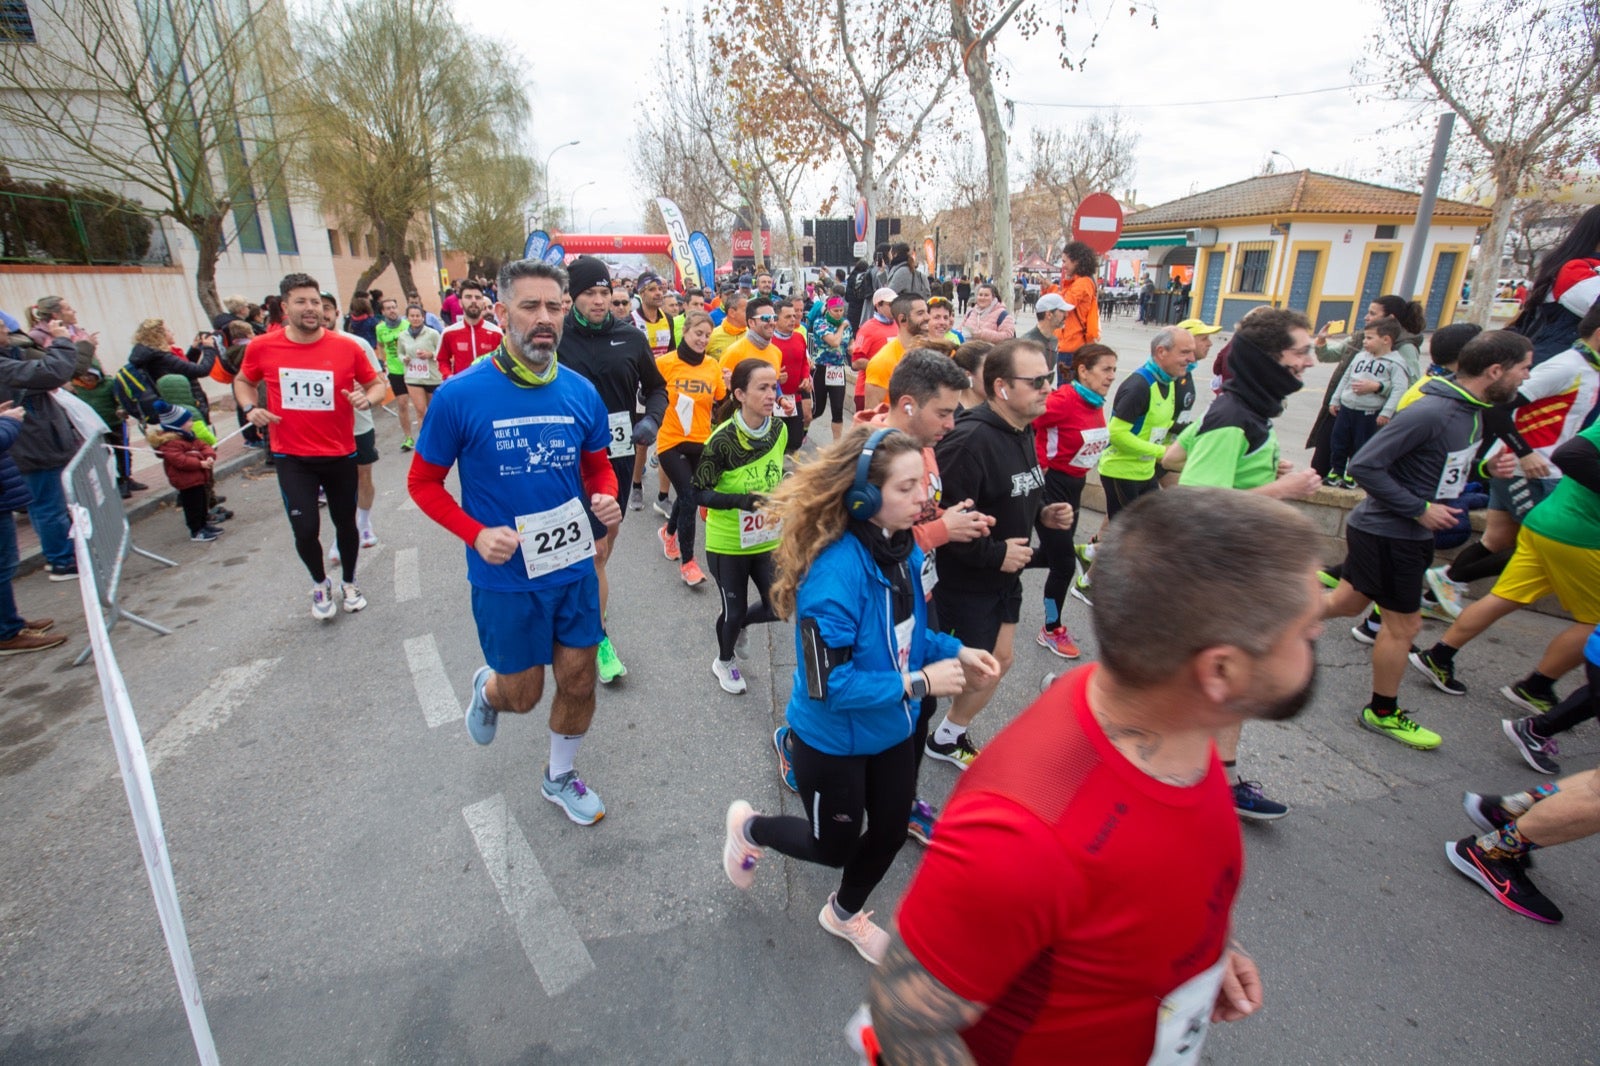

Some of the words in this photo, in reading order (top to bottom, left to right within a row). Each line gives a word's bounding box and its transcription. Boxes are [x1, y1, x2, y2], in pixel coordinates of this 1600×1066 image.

[1354, 359, 1385, 377] GAP
[290, 381, 324, 397] 119
[675, 379, 712, 394] HSN
[534, 521, 581, 555] 223
